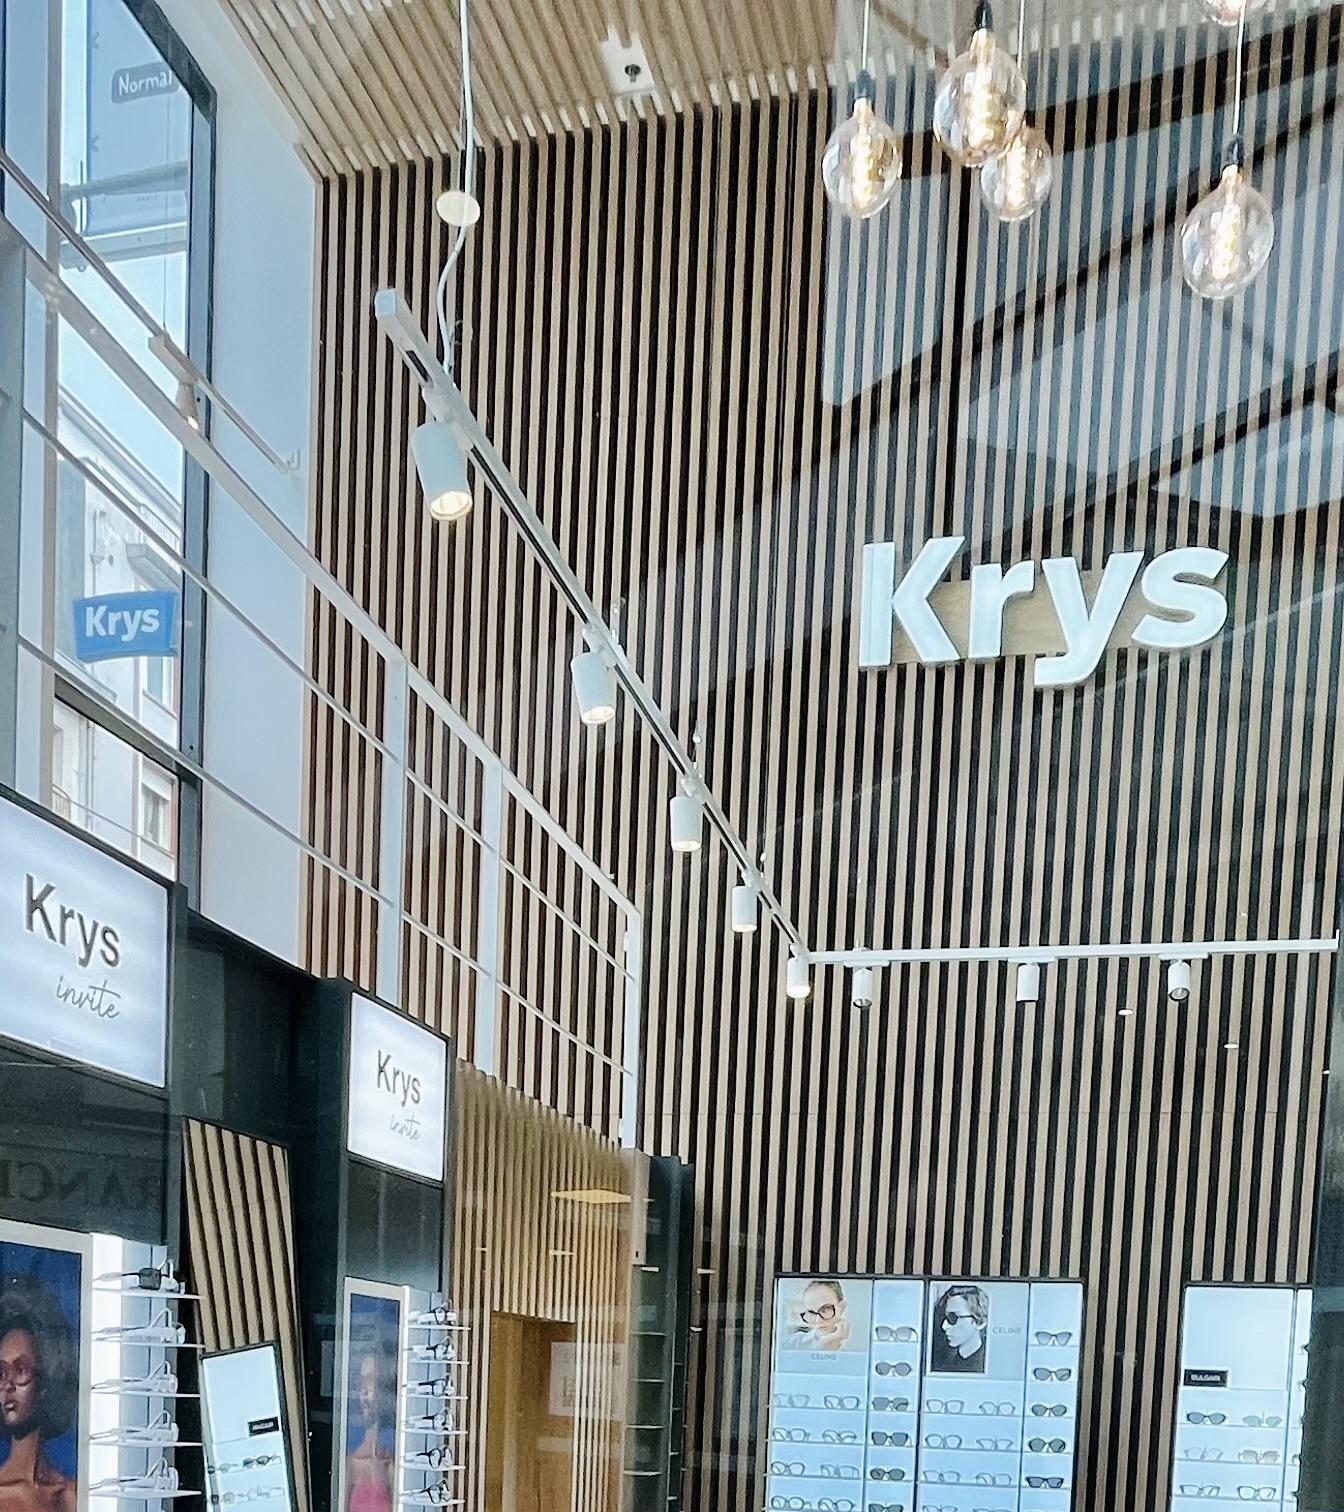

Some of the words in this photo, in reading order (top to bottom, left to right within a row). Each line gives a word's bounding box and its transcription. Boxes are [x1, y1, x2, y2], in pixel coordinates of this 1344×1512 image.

[118, 70, 173, 97] Normal
[84, 604, 160, 642] Krys
[858, 535, 1230, 687] Krys
[25, 872, 121, 969] Krys
[56, 974, 122, 1020] invite
[376, 1049, 422, 1108] Krys
